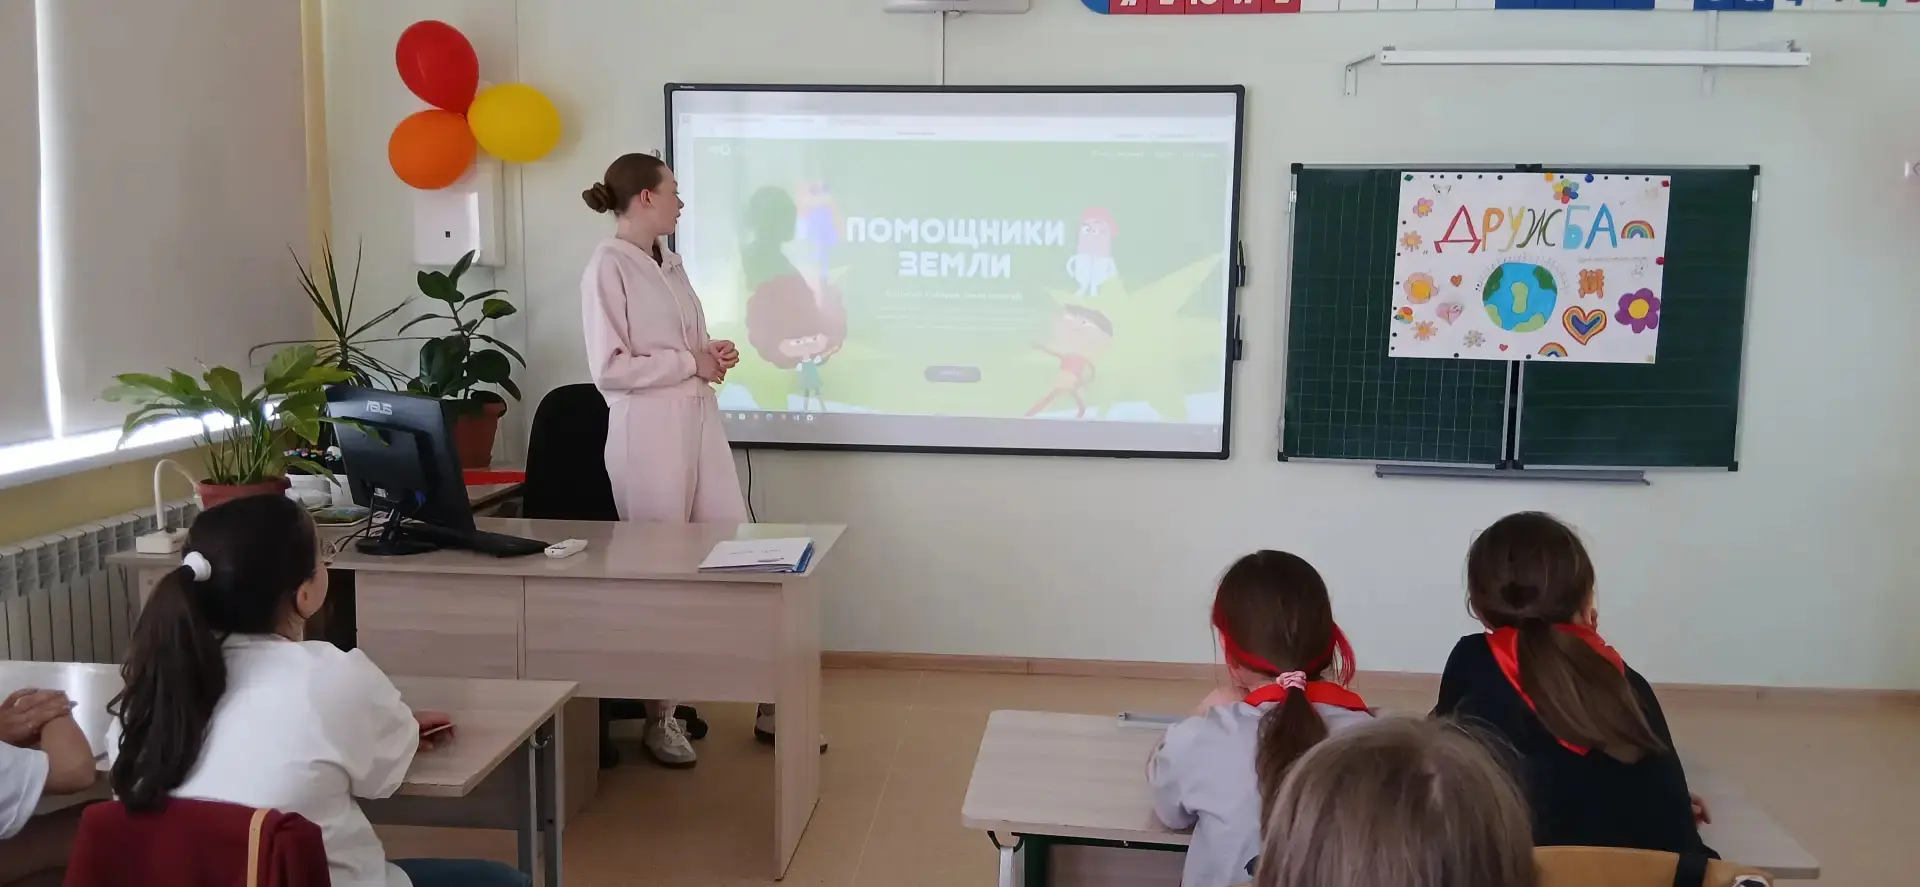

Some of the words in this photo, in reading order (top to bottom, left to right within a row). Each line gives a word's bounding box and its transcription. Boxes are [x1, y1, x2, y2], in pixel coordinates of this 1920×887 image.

[846, 216, 1065, 249] ПОМОЩНИКИ
[1434, 203, 1618, 254] ДРУЖБА
[899, 251, 1011, 279] ЗЕМЛИ
[366, 400, 393, 416] ASUS
